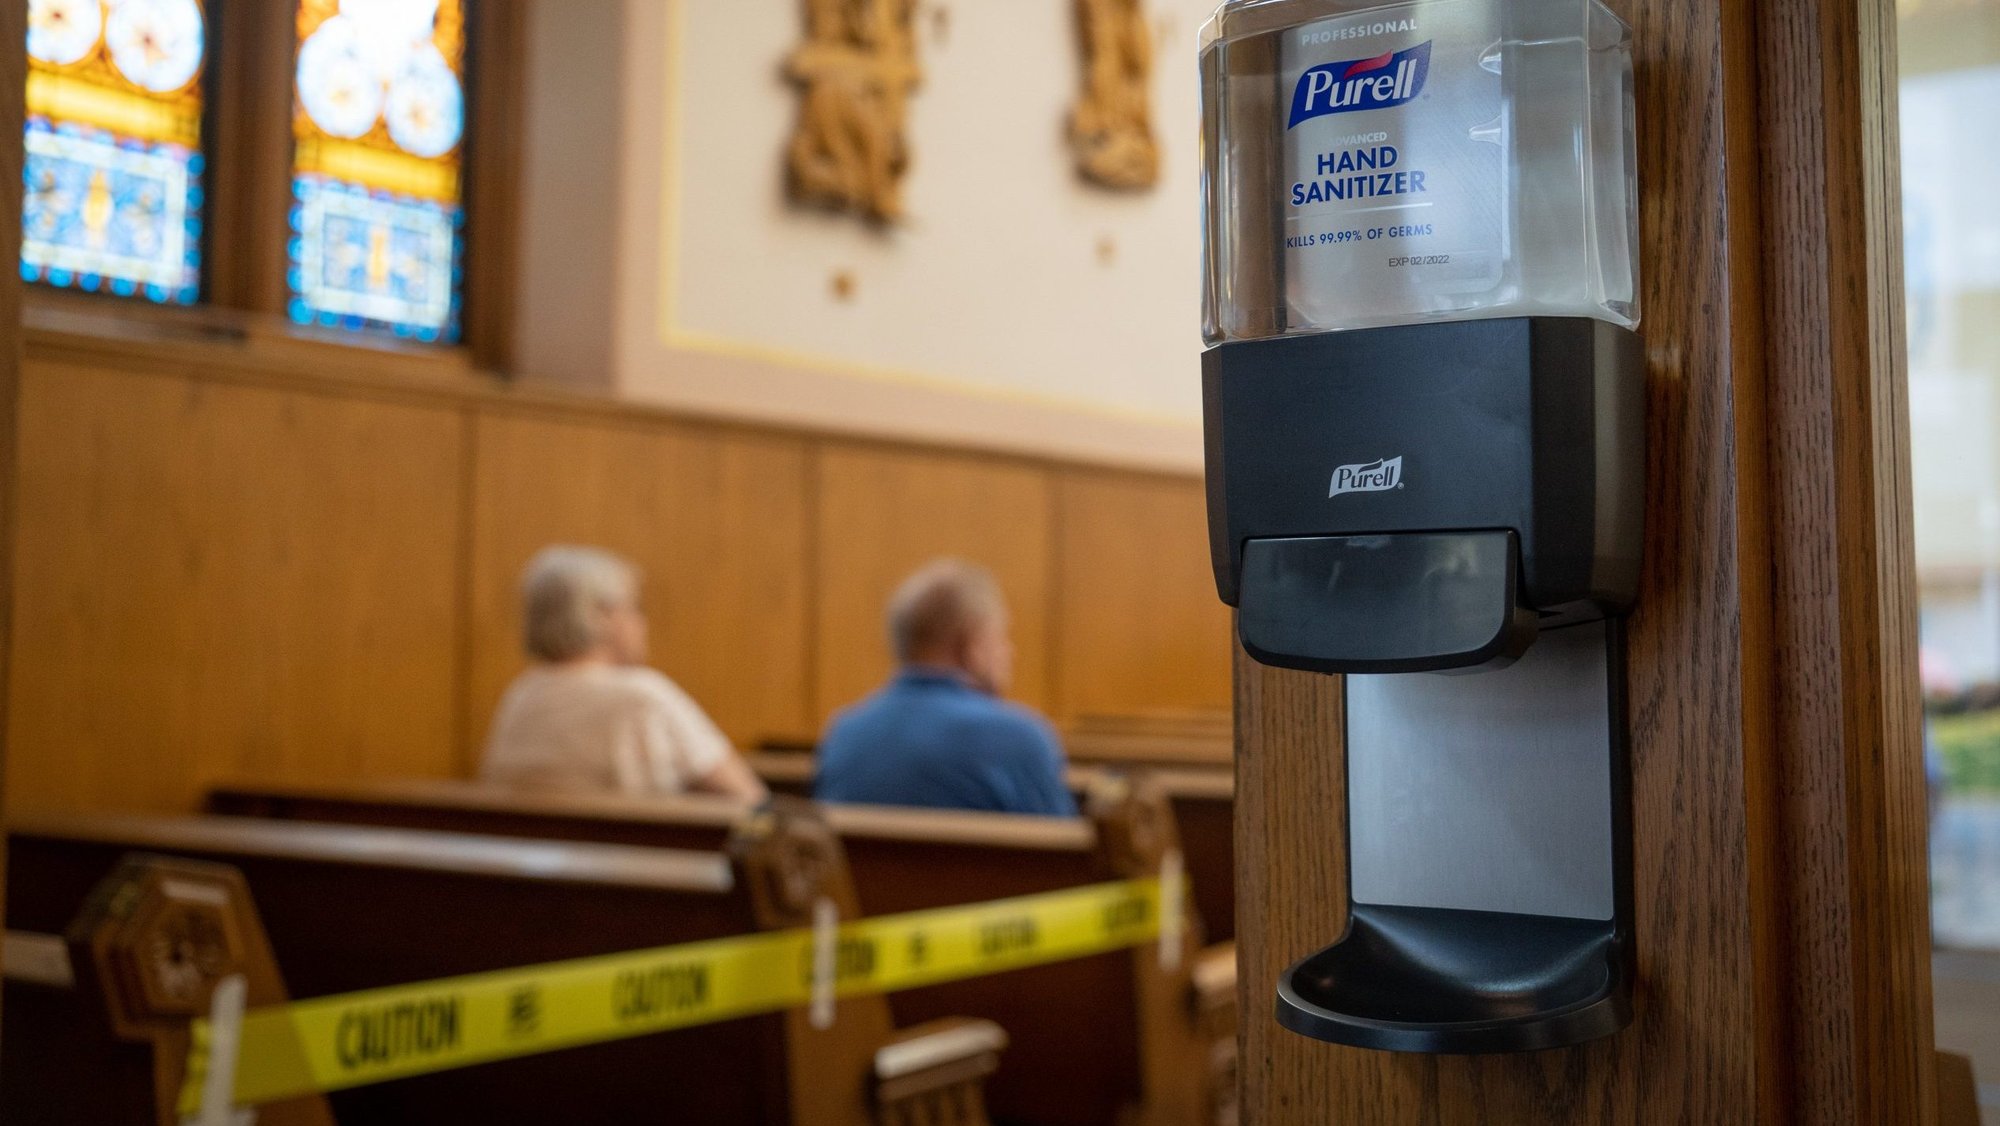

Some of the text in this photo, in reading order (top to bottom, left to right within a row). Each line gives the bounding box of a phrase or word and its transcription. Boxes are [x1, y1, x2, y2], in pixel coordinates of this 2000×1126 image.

[1302, 18, 1417, 46] PROFESSIONAL
[1304, 58, 1418, 111] Purell
[1317, 146, 1398, 175] HAND
[1291, 170, 1427, 206] SANITIZER
[1286, 224, 1432, 249] KILLS 99.99% OF GERMS
[1388, 255, 1450, 267] EXP 02/2022
[1337, 465, 1395, 489] Purell
[335, 993, 462, 1070] CAUTION
